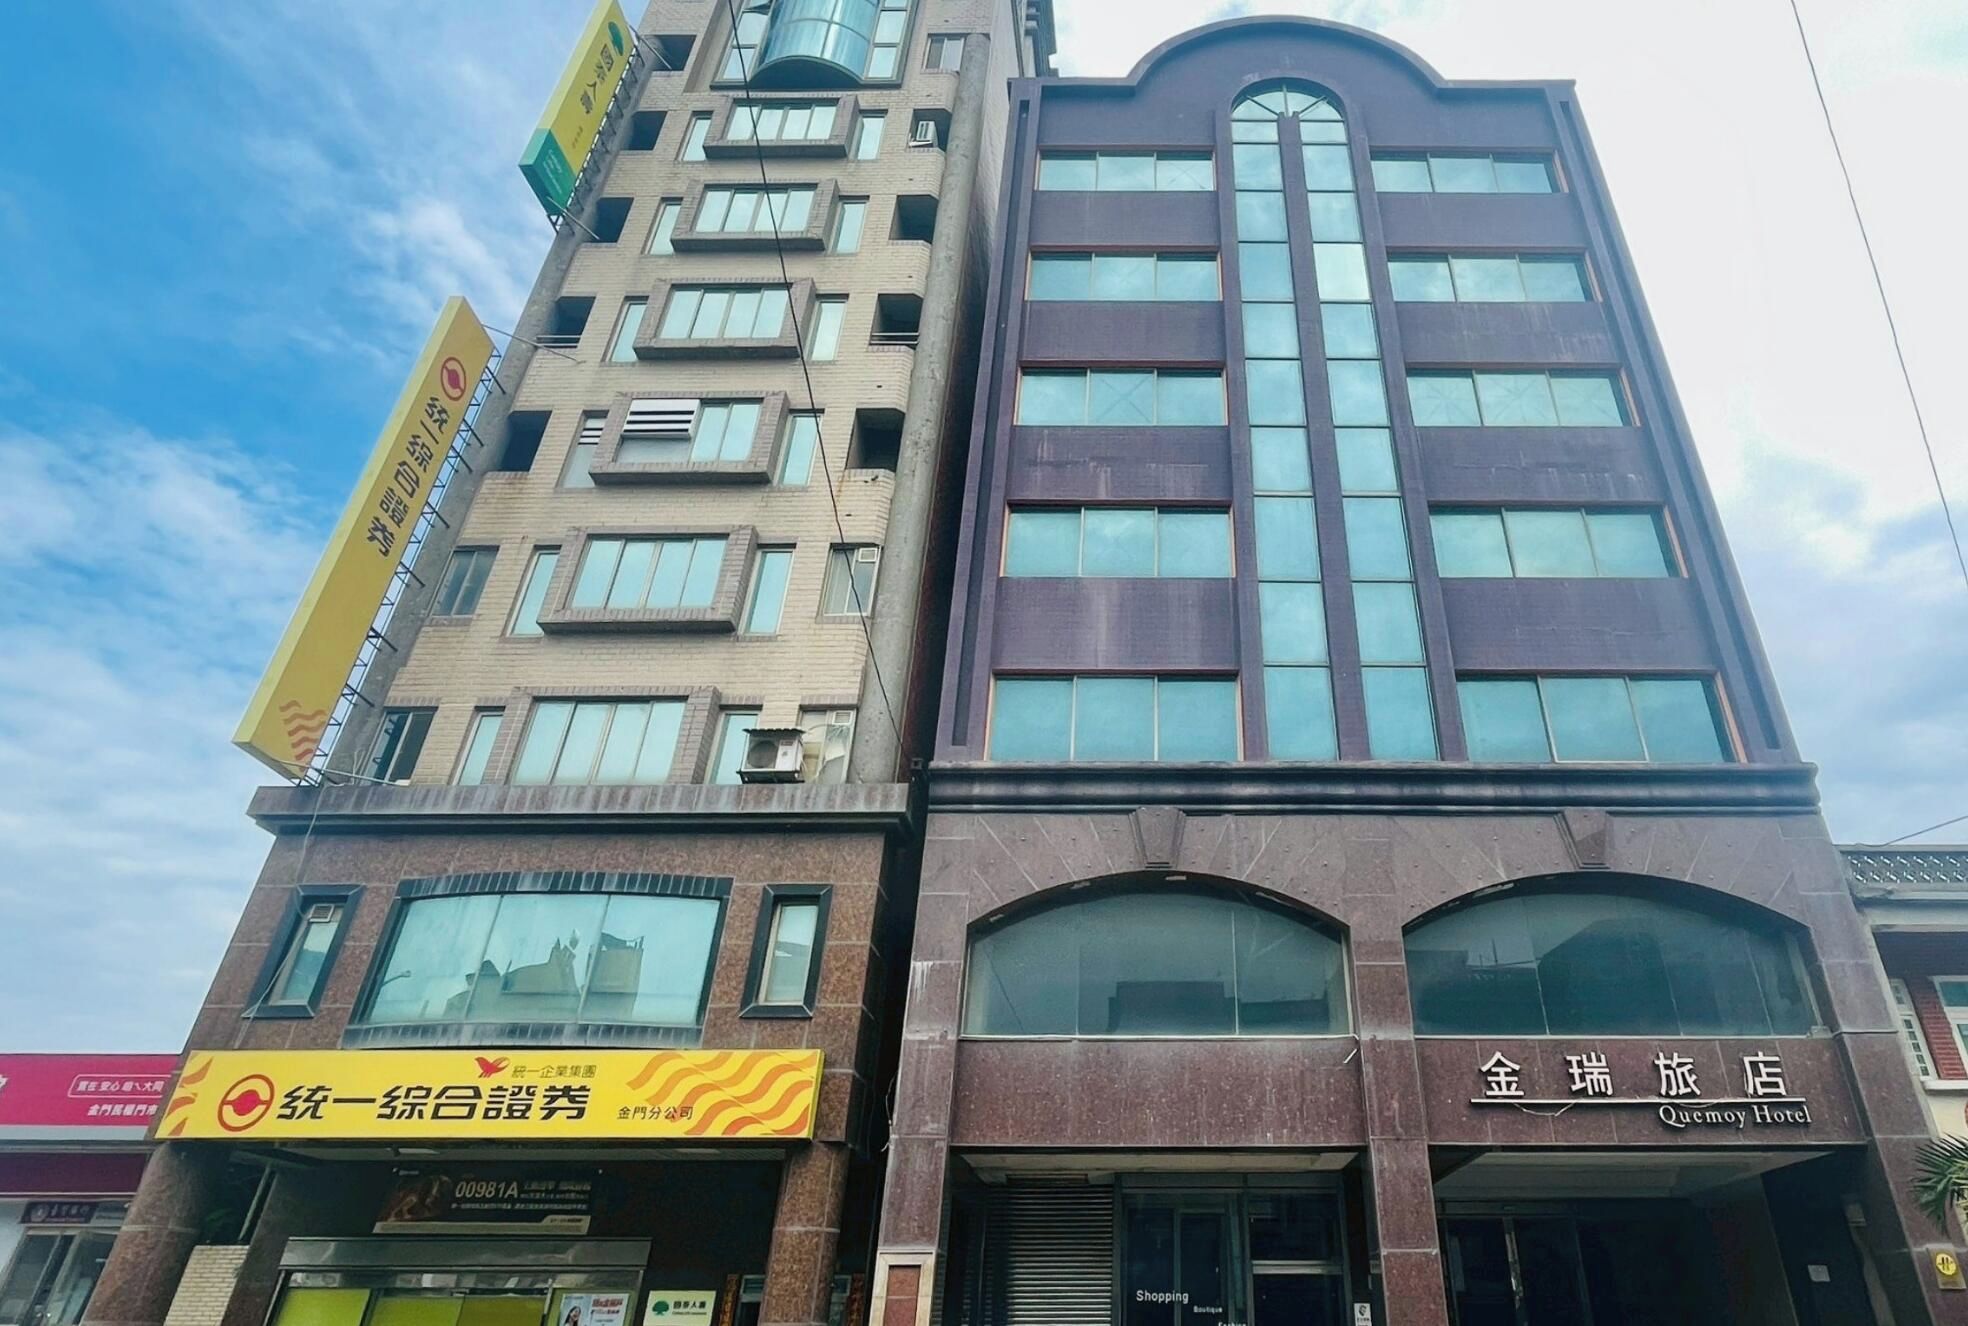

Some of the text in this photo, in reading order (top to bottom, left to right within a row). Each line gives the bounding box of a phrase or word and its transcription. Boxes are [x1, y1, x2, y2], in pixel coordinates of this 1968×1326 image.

[366, 396, 450, 558] 統一綜合證券
[512, 1065, 597, 1078] 統一企業集團
[1480, 1051, 1788, 1098] 金瑞旅店
[276, 1086, 591, 1120] 統一綜合證券
[617, 1106, 694, 1120] 金門分公司
[1659, 1104, 1812, 1128] Quemoy Hotel
[455, 1181, 518, 1199] 00981A
[1135, 1289, 1190, 1304] Shopping
